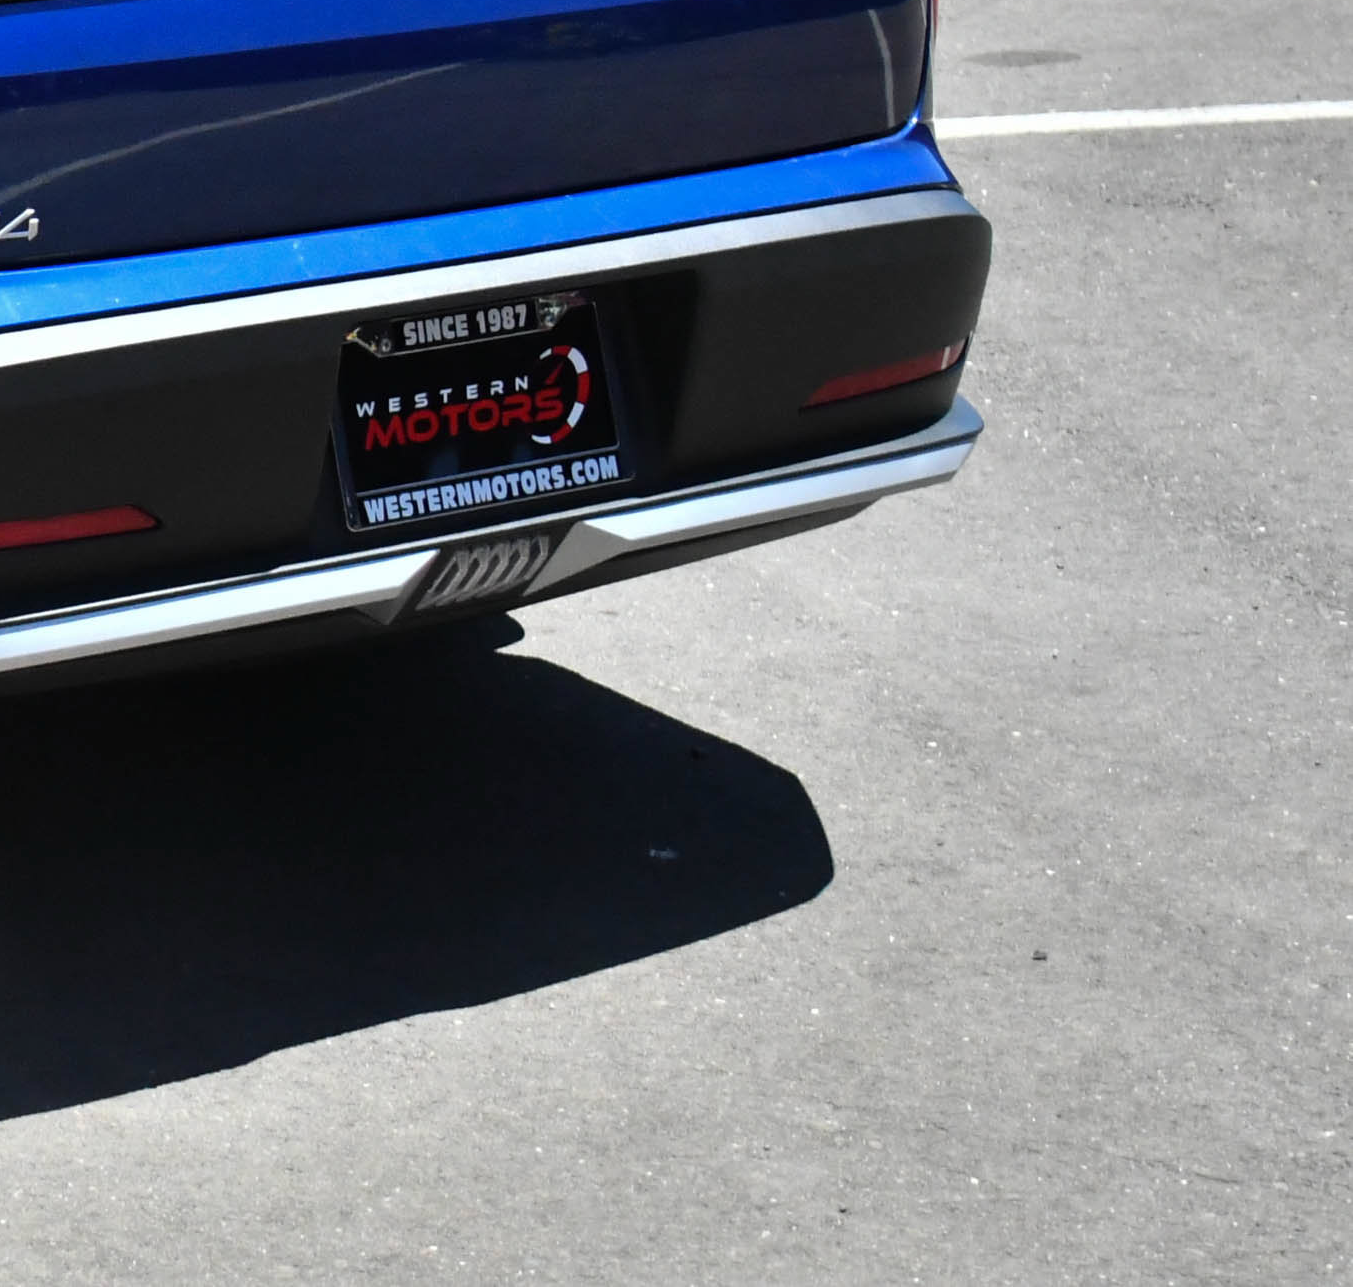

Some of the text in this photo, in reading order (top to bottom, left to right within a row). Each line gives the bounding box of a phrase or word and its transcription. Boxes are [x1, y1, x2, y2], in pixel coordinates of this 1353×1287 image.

[403, 304, 528, 346] SINCE 1987
[356, 376, 529, 417] WESTERN
[365, 387, 564, 451] MOTORS
[364, 455, 619, 524] WESTERNMOTORS.COM
